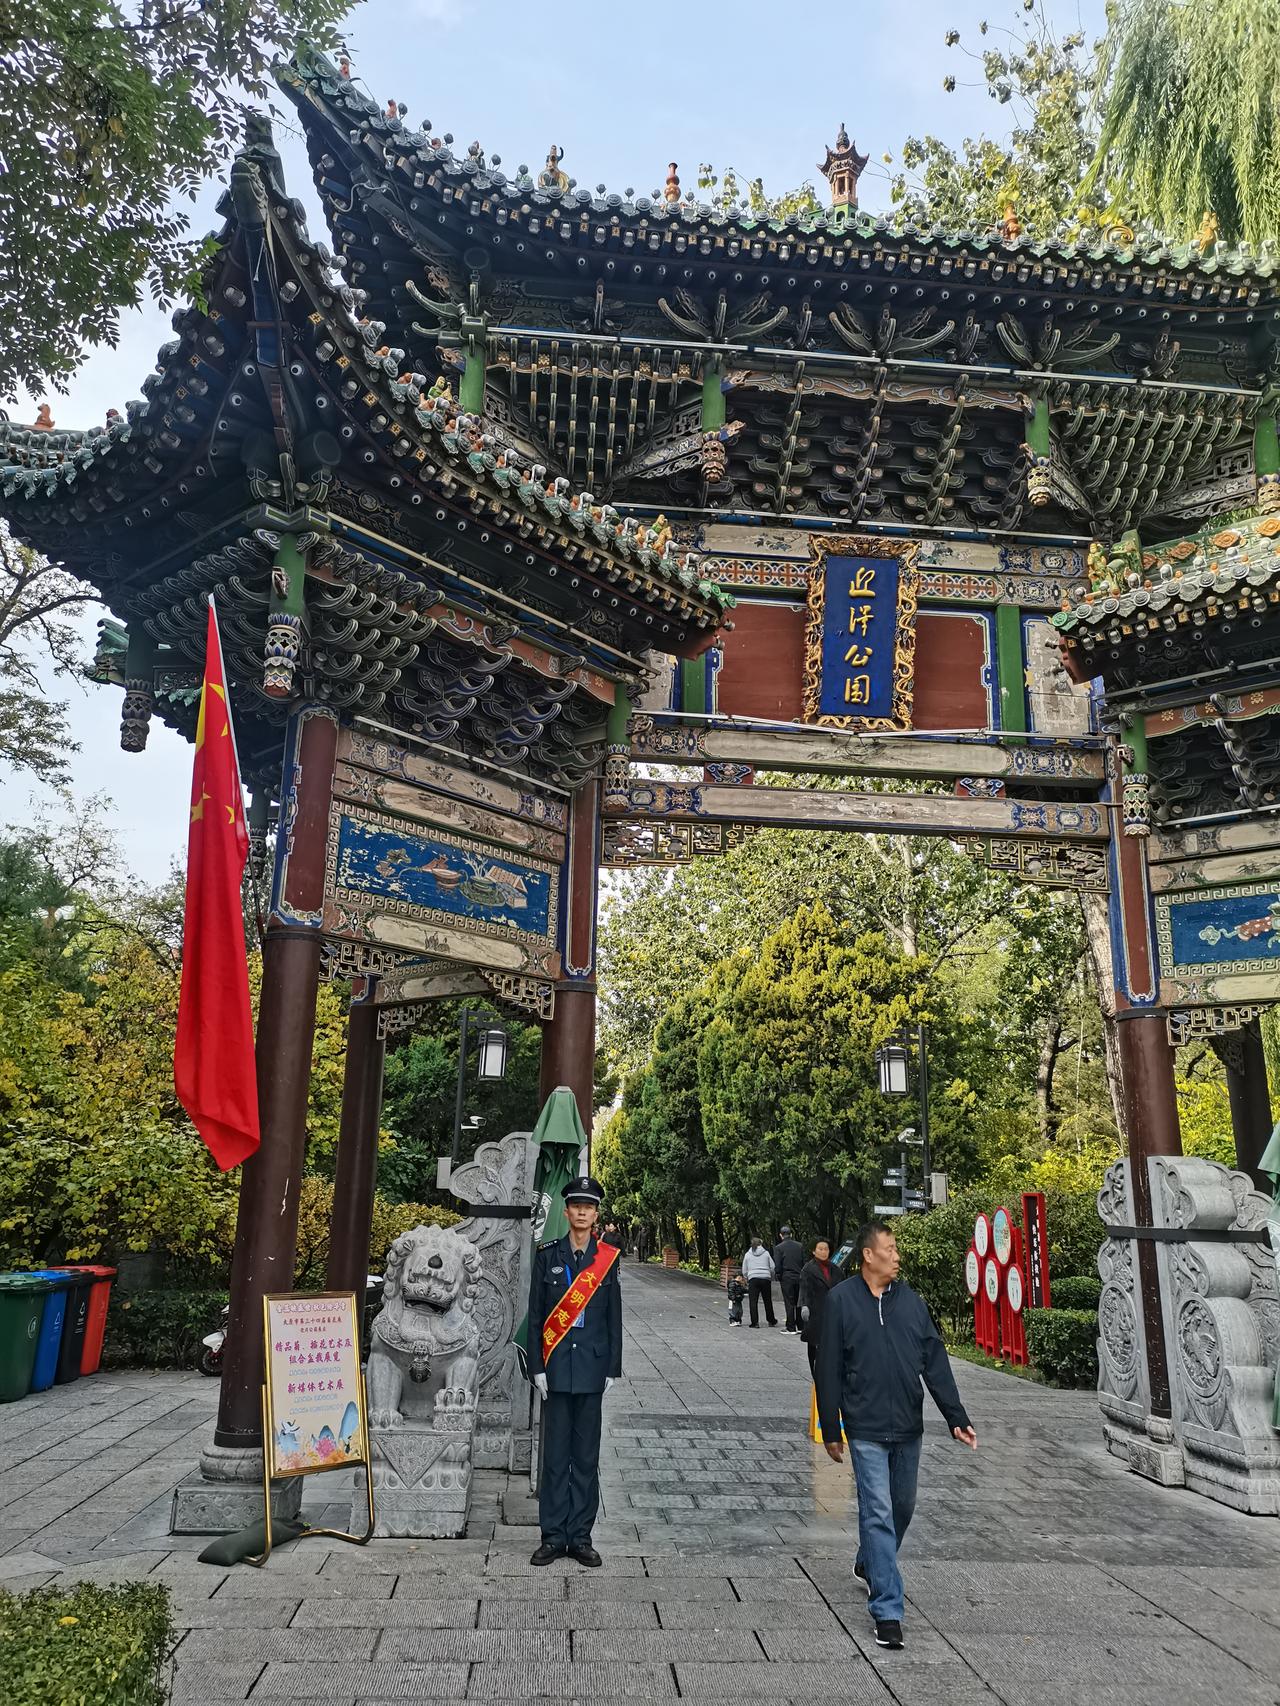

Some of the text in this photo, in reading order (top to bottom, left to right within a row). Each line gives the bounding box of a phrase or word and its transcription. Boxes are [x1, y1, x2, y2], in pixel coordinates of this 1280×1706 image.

[844, 566, 876, 704] 迎泽公园
[288, 1379, 344, 1393] 新媒体艺术展
